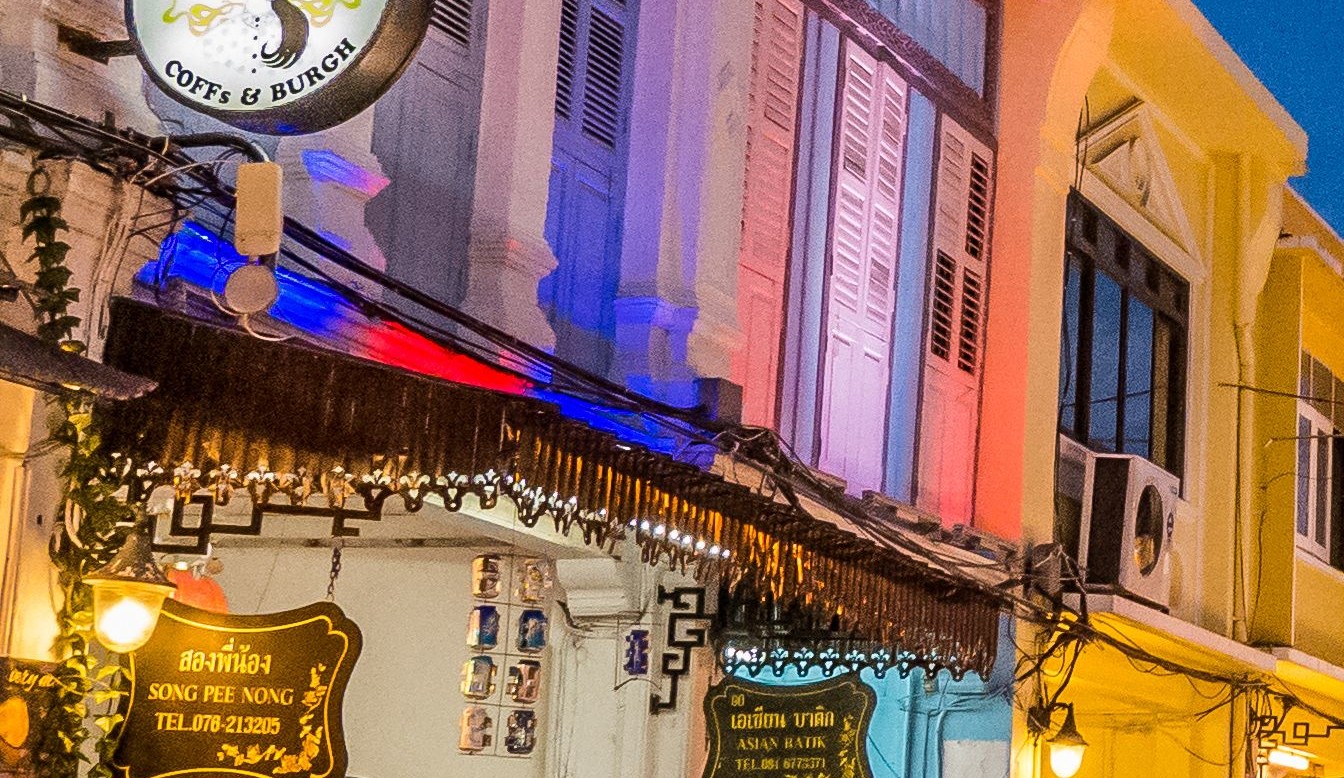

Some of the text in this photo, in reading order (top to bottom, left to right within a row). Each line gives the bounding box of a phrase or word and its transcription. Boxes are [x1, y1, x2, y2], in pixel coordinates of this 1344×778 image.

[165, 37, 357, 105] COFFs & BURGH
[178, 637, 272, 675] สองพี่น้อง
[148, 683, 294, 706] SONG PEE NONG
[737, 736, 826, 750] ASIAN BATIK
